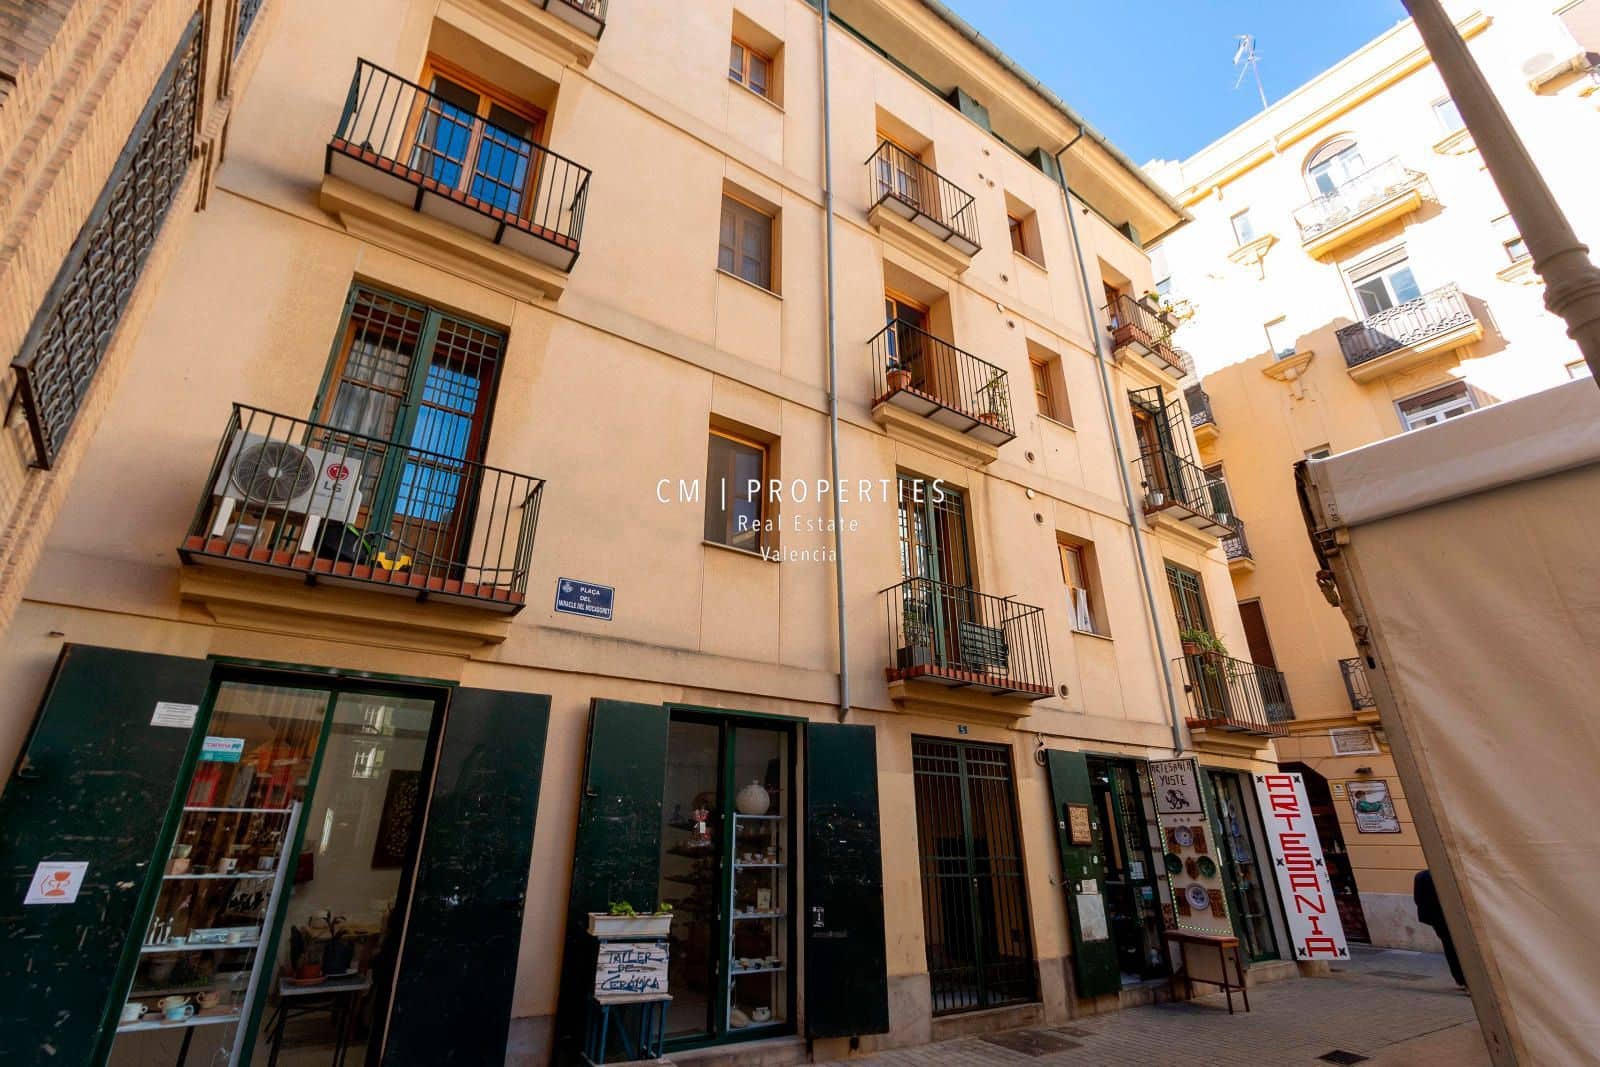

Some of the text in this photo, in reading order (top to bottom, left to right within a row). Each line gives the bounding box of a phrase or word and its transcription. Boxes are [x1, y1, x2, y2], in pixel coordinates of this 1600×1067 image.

[580, 587, 600, 595] PLAÇA
[1159, 774, 1188, 787] YUSTE
[1264, 775, 1339, 958] ARTESANIA
[602, 949, 665, 964] TALLER
